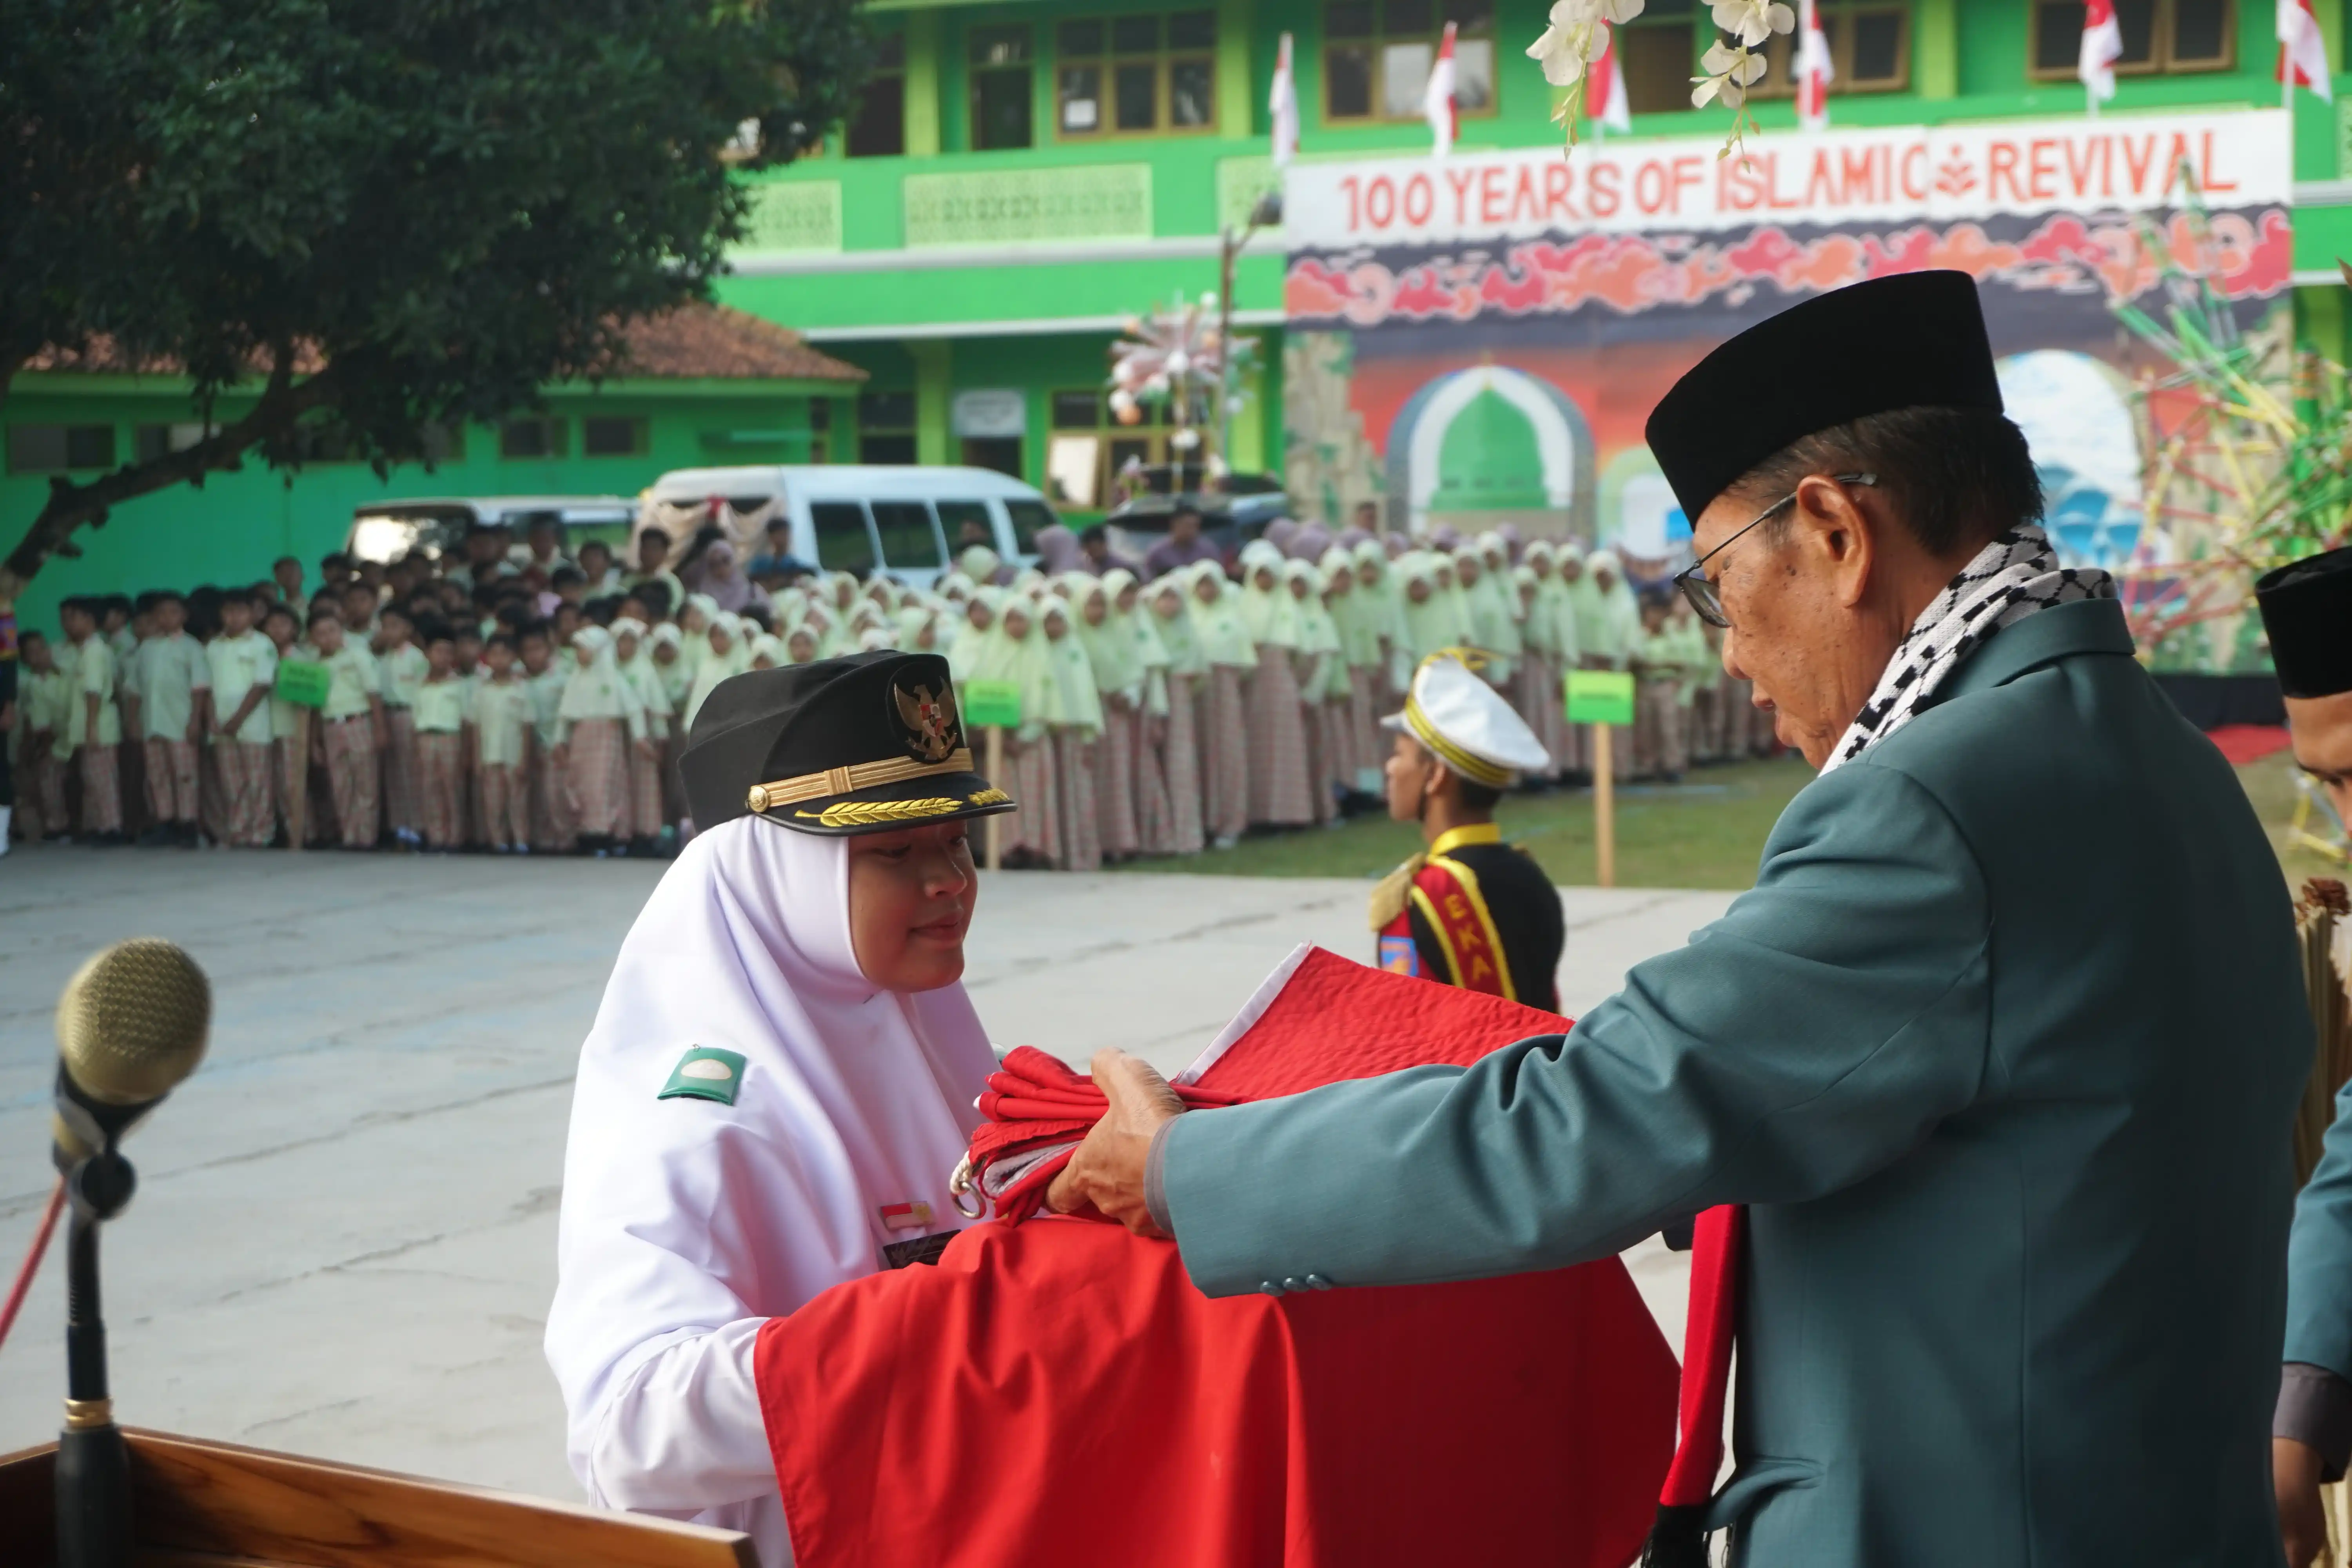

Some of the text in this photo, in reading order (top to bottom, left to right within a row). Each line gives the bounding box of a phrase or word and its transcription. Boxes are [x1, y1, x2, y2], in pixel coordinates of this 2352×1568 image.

[1339, 131, 2238, 232] 100 YEARS OF ISLAMIC REVIVAL
[1444, 894, 1492, 981] EKA
